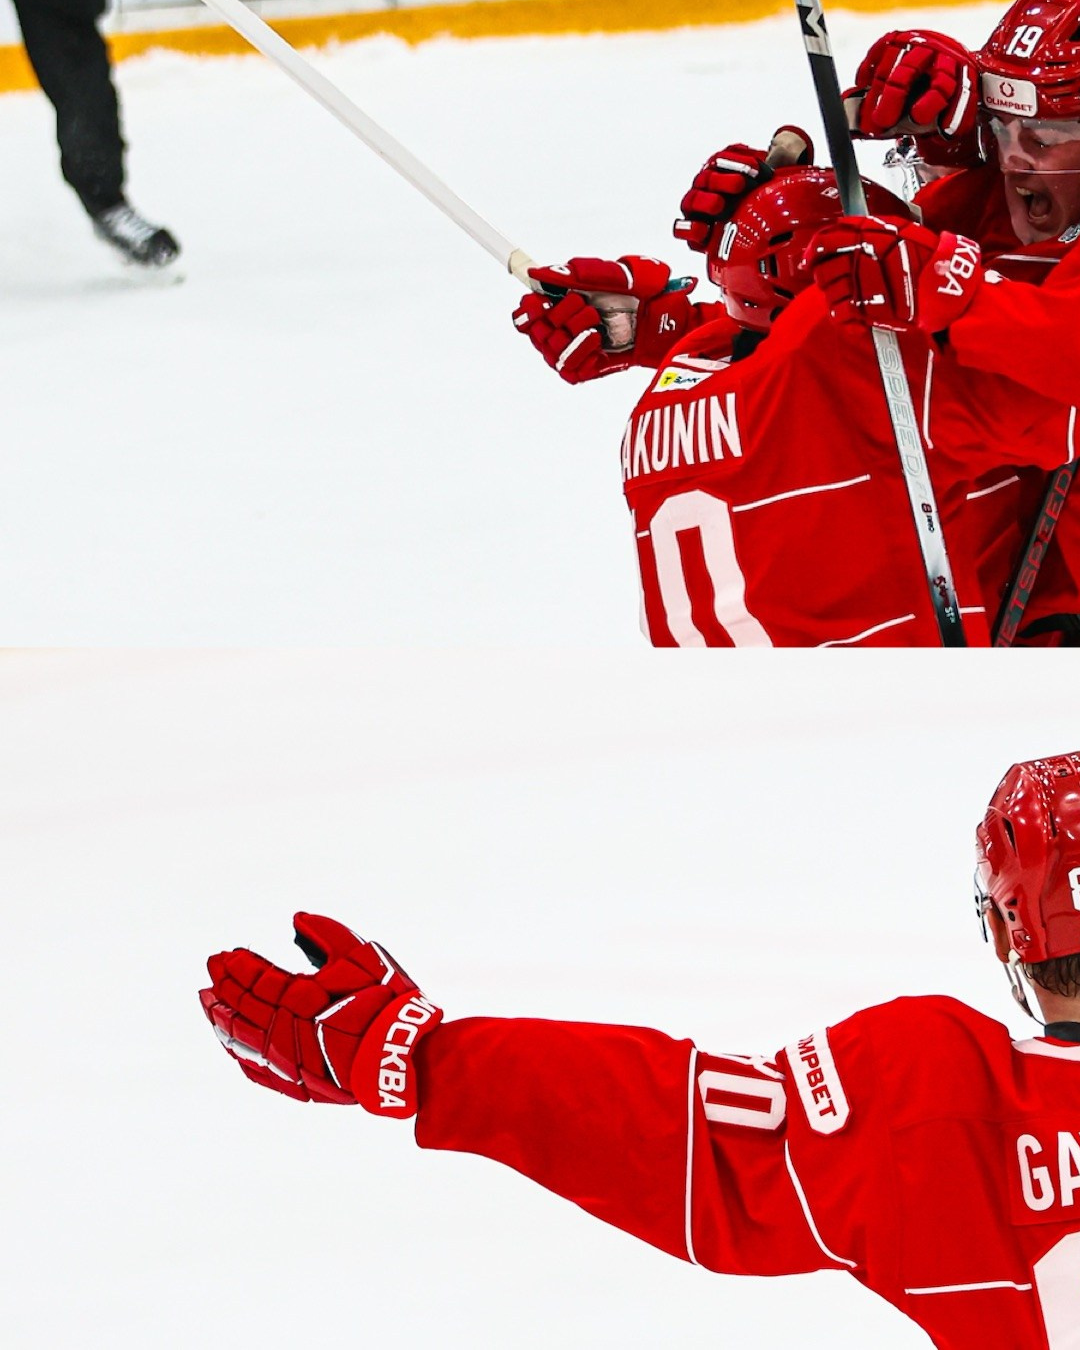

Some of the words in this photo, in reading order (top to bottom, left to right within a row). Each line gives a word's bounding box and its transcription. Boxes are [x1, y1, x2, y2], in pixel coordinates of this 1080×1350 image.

[1005, 25, 1044, 58] 19
[986, 95, 1033, 113] OLIMPBET
[798, 1034, 838, 1117] MPBET
